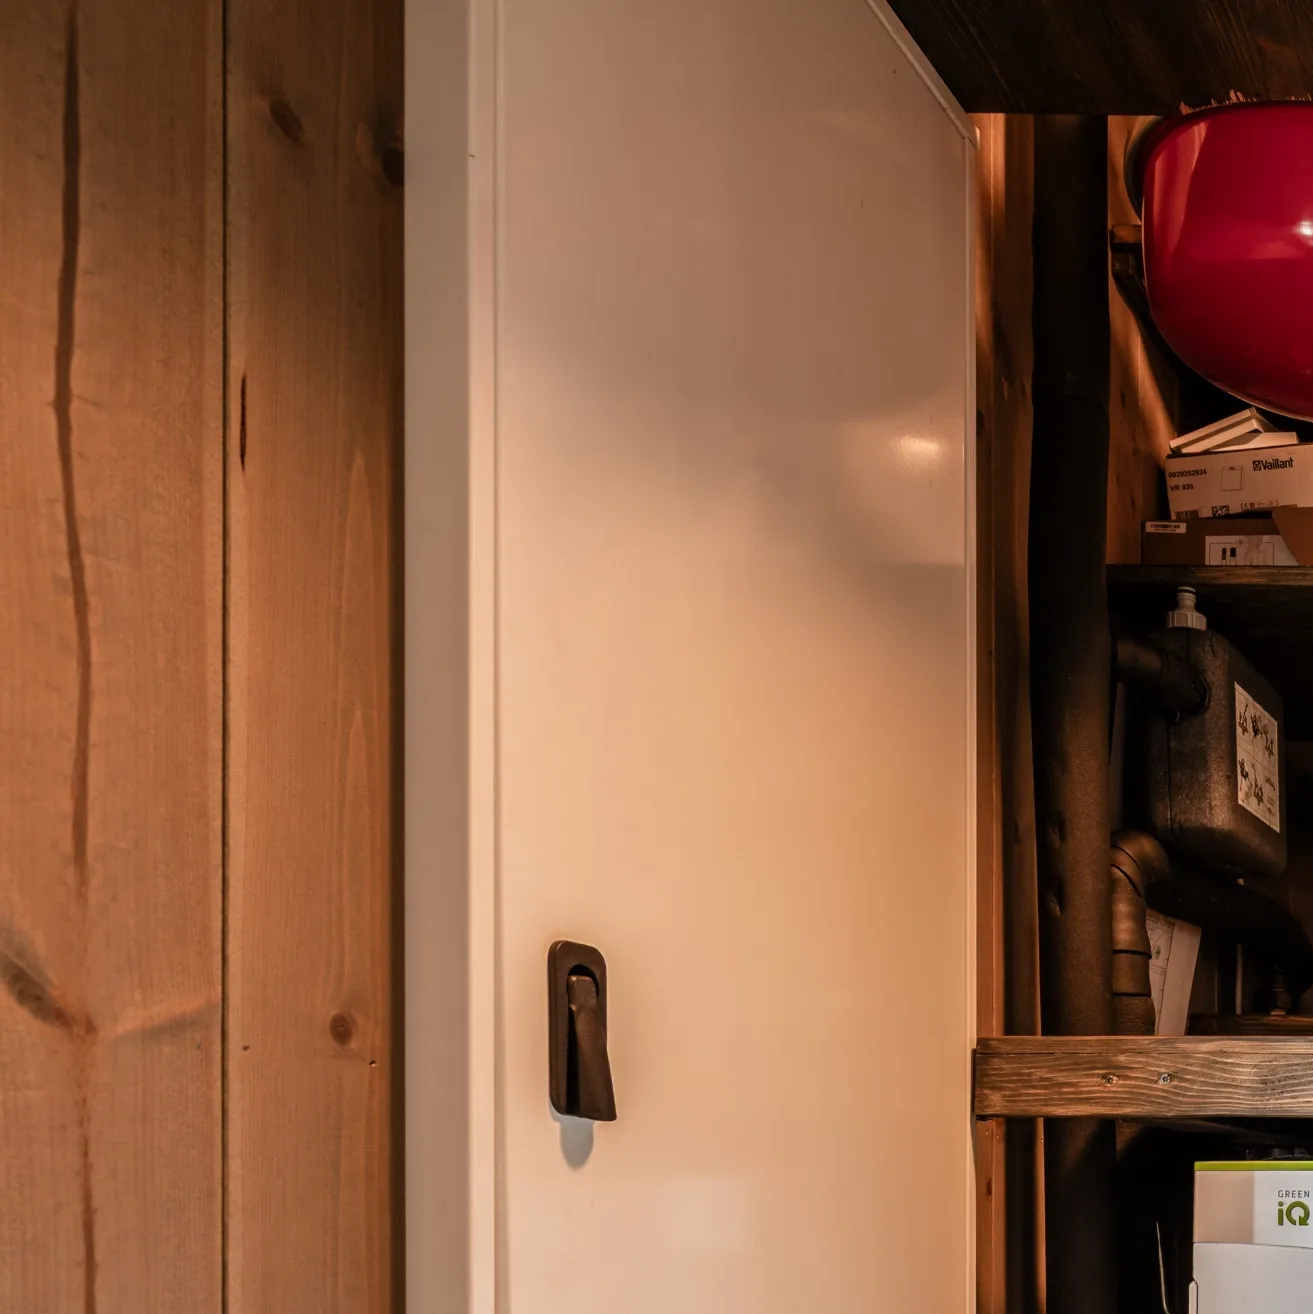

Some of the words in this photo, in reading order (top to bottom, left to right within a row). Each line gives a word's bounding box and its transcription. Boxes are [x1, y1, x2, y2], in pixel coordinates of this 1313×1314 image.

[1261, 457, 1293, 470] Vaillant
[1170, 484, 1180, 492] VR
[1181, 483, 1194, 491] 920
[1277, 1189, 1310, 1198] GREEN
[1277, 1200, 1310, 1226] iQ
